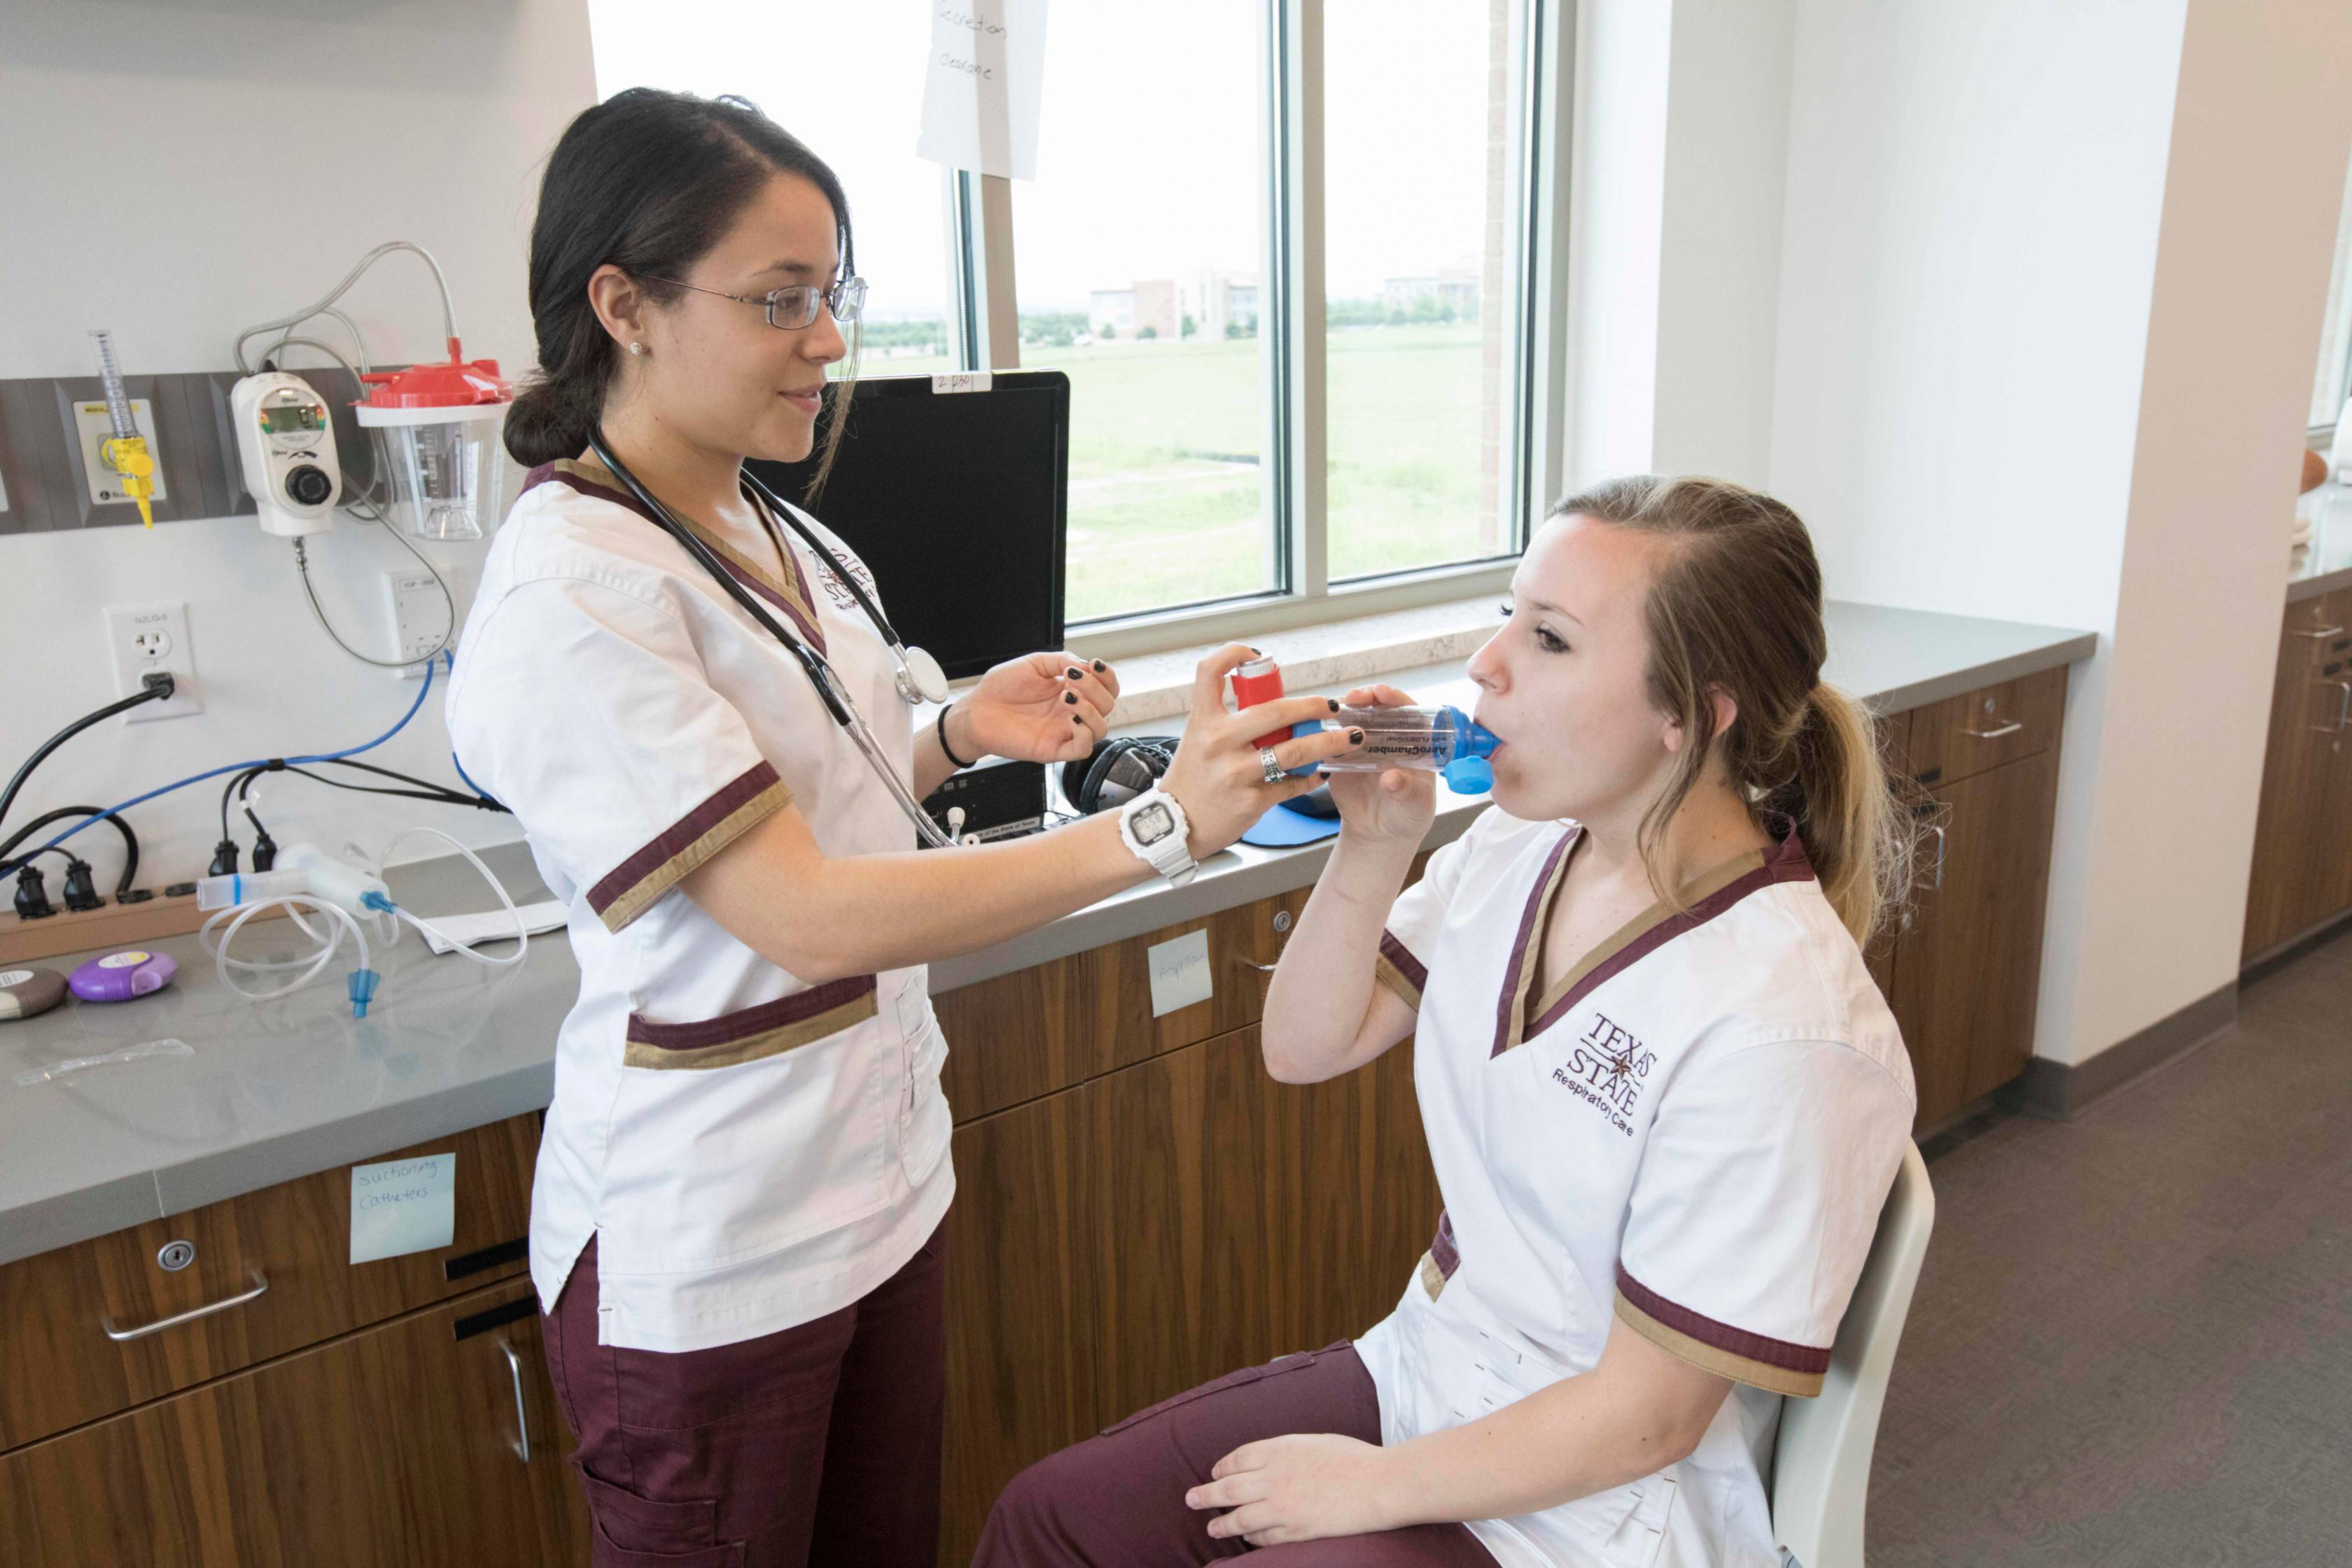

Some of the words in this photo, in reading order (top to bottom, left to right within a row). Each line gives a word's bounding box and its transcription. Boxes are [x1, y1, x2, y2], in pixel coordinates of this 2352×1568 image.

[1367, 746, 1447, 756] AeroChamber
[1588, 1012, 1658, 1077] TEXAS
[1552, 1068, 1612, 1119] Respiratory
[1611, 1112, 1633, 1136] Care
[1567, 1049, 1637, 1116] STATE
